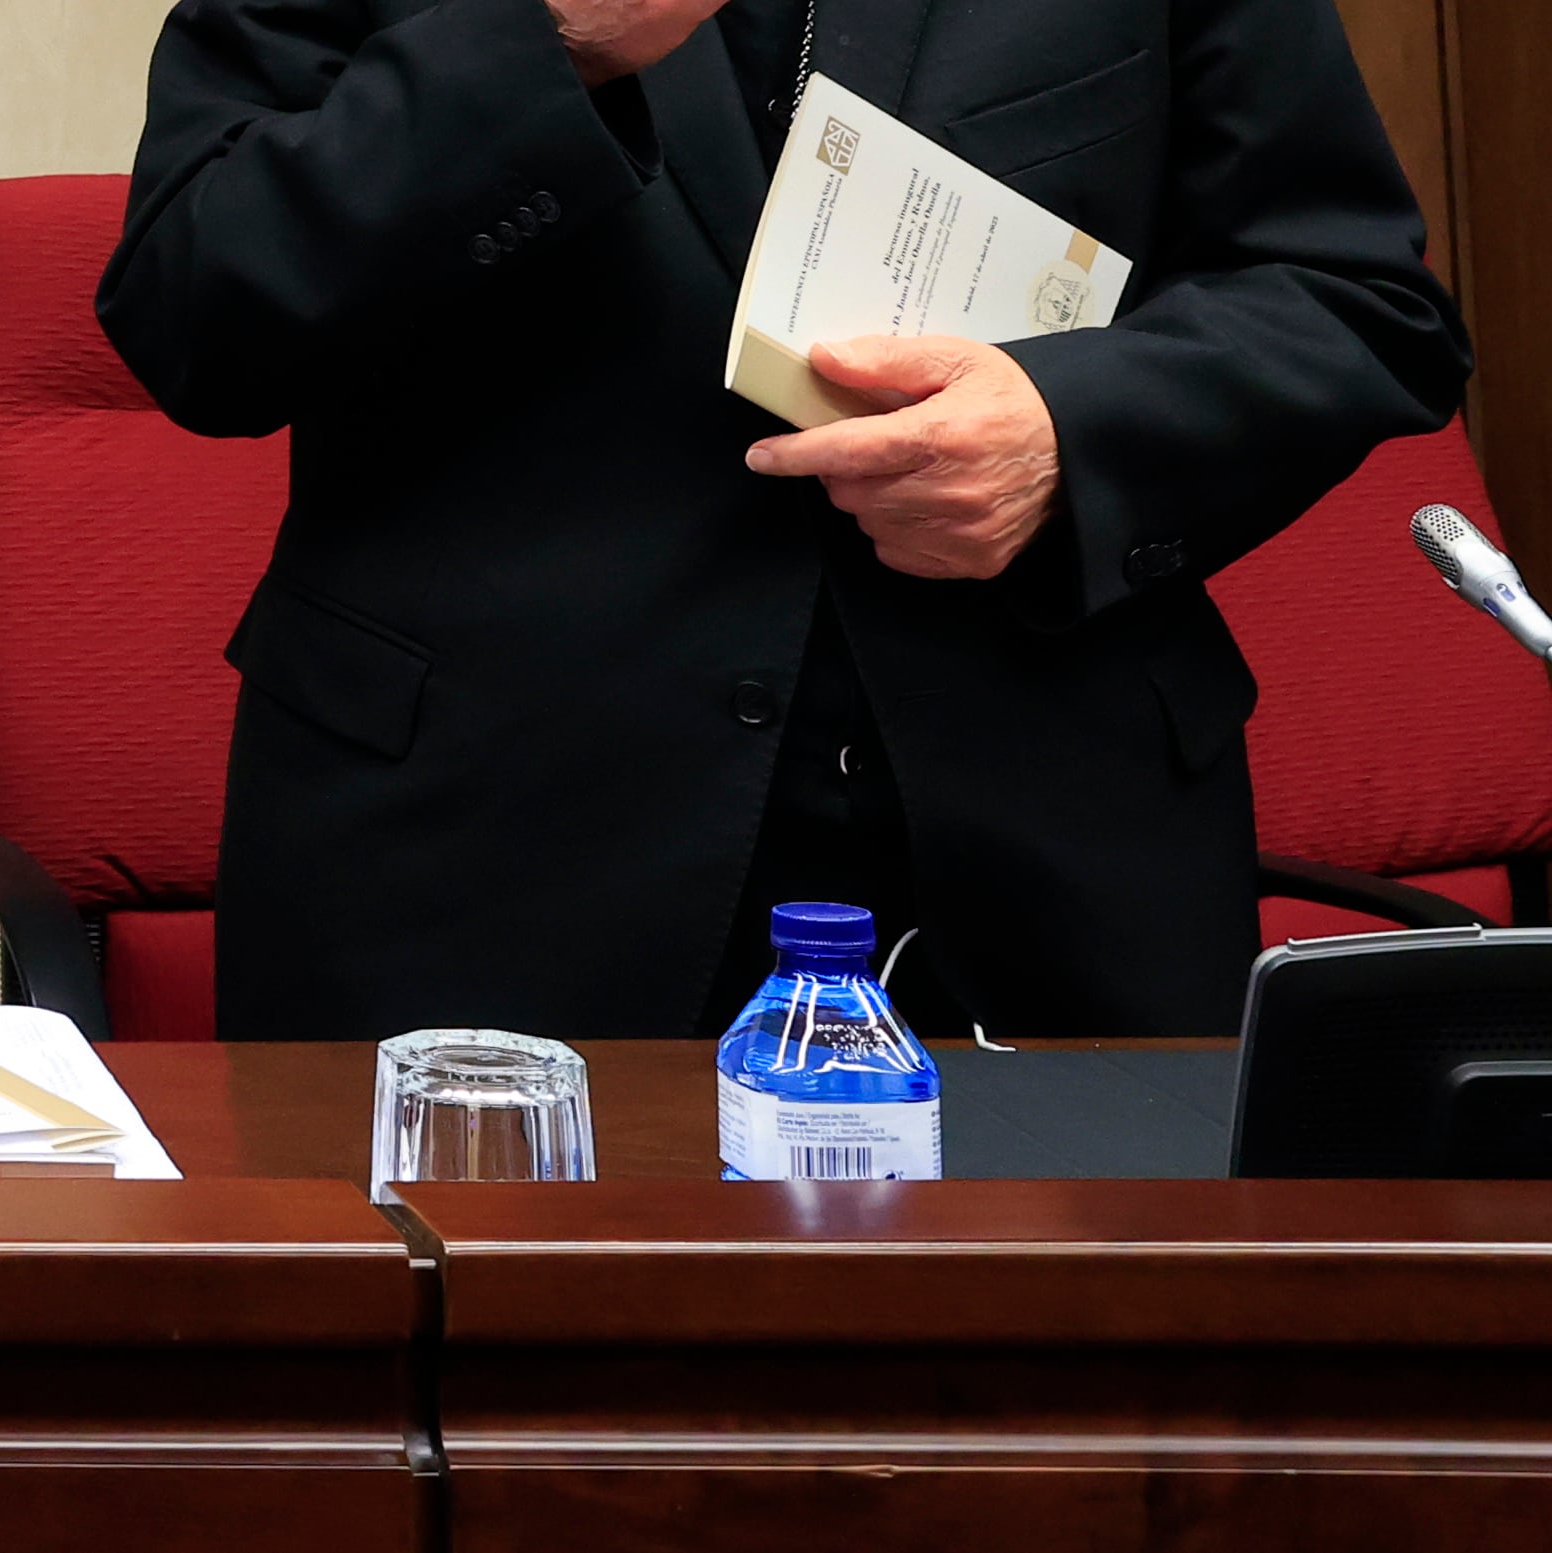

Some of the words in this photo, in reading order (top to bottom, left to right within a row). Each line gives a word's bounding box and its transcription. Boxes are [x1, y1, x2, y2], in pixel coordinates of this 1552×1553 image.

[883, 222, 902, 267] Discurso
[898, 168, 919, 220] inaugural
[788, 271, 807, 333] CONFERENCIA
[803, 222, 820, 268] EPISCOPAL
[816, 174, 835, 219] ESPAÑOLA
[891, 267, 902, 284] del
[904, 261, 915, 284] José
